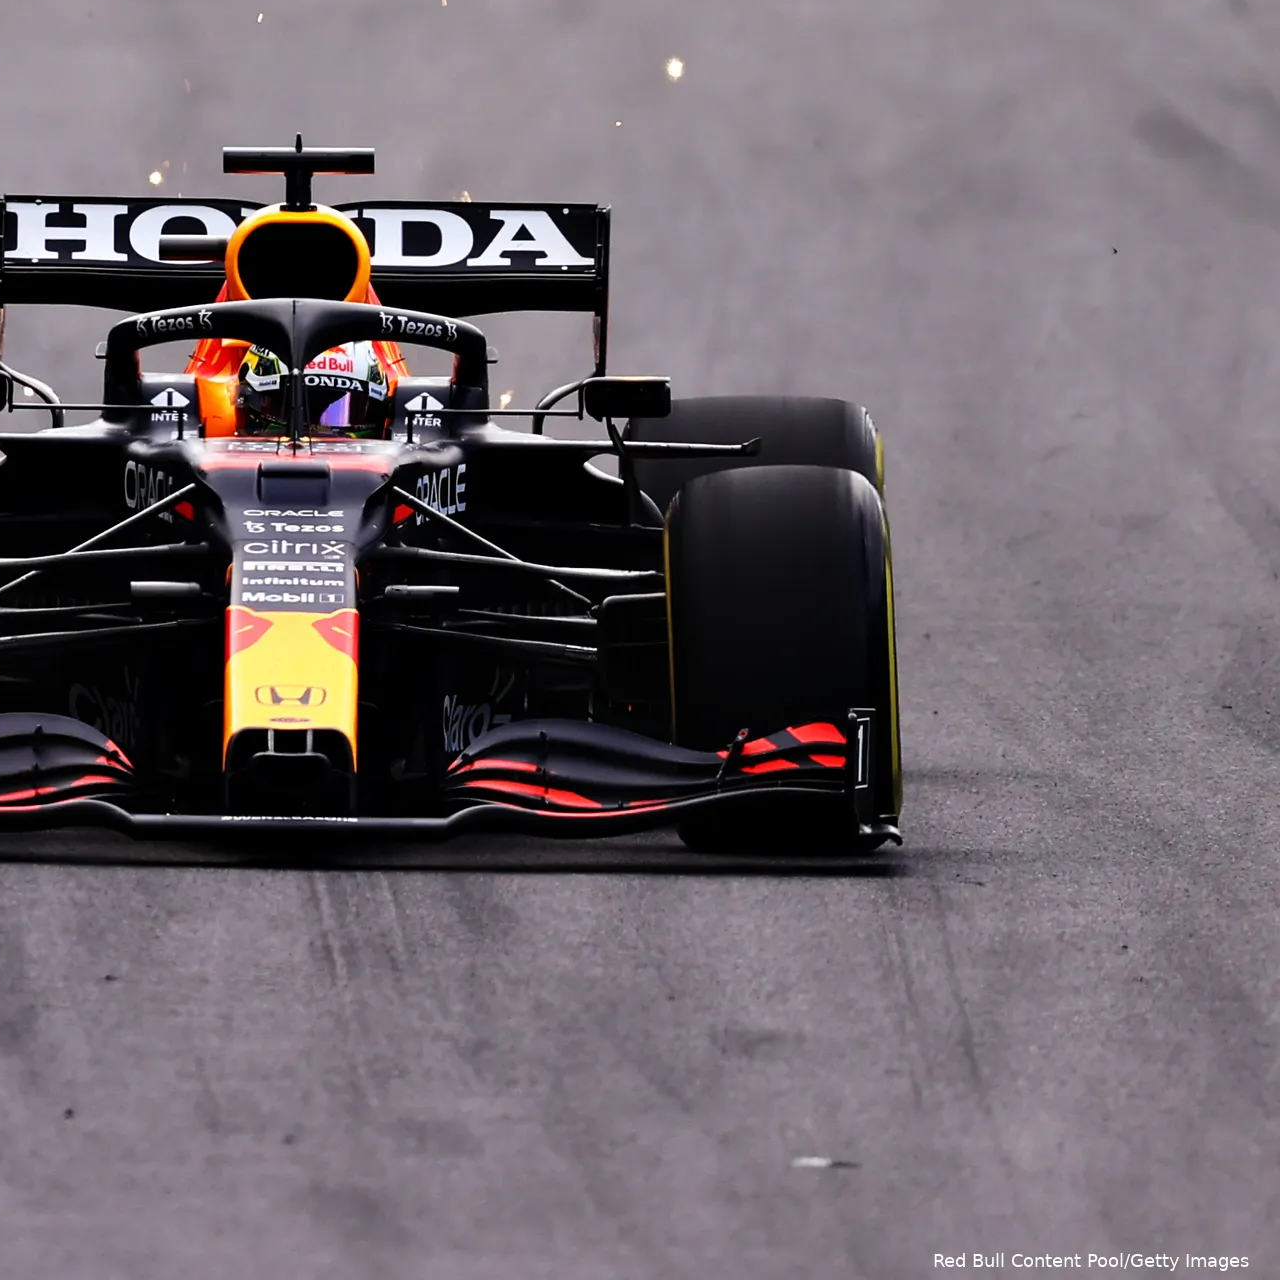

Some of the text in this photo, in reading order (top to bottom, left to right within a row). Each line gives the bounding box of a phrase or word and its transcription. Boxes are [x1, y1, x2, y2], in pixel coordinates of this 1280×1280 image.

[4, 202, 595, 268] HODA
[151, 316, 194, 332] Tezos
[397, 315, 443, 337] Tezos
[304, 357, 354, 373] ed Bull
[304, 375, 364, 392] ONDA
[243, 509, 344, 517] ORACLE
[271, 522, 345, 533] Tezos
[242, 577, 344, 586] infinitum
[241, 592, 315, 603] Mobil
